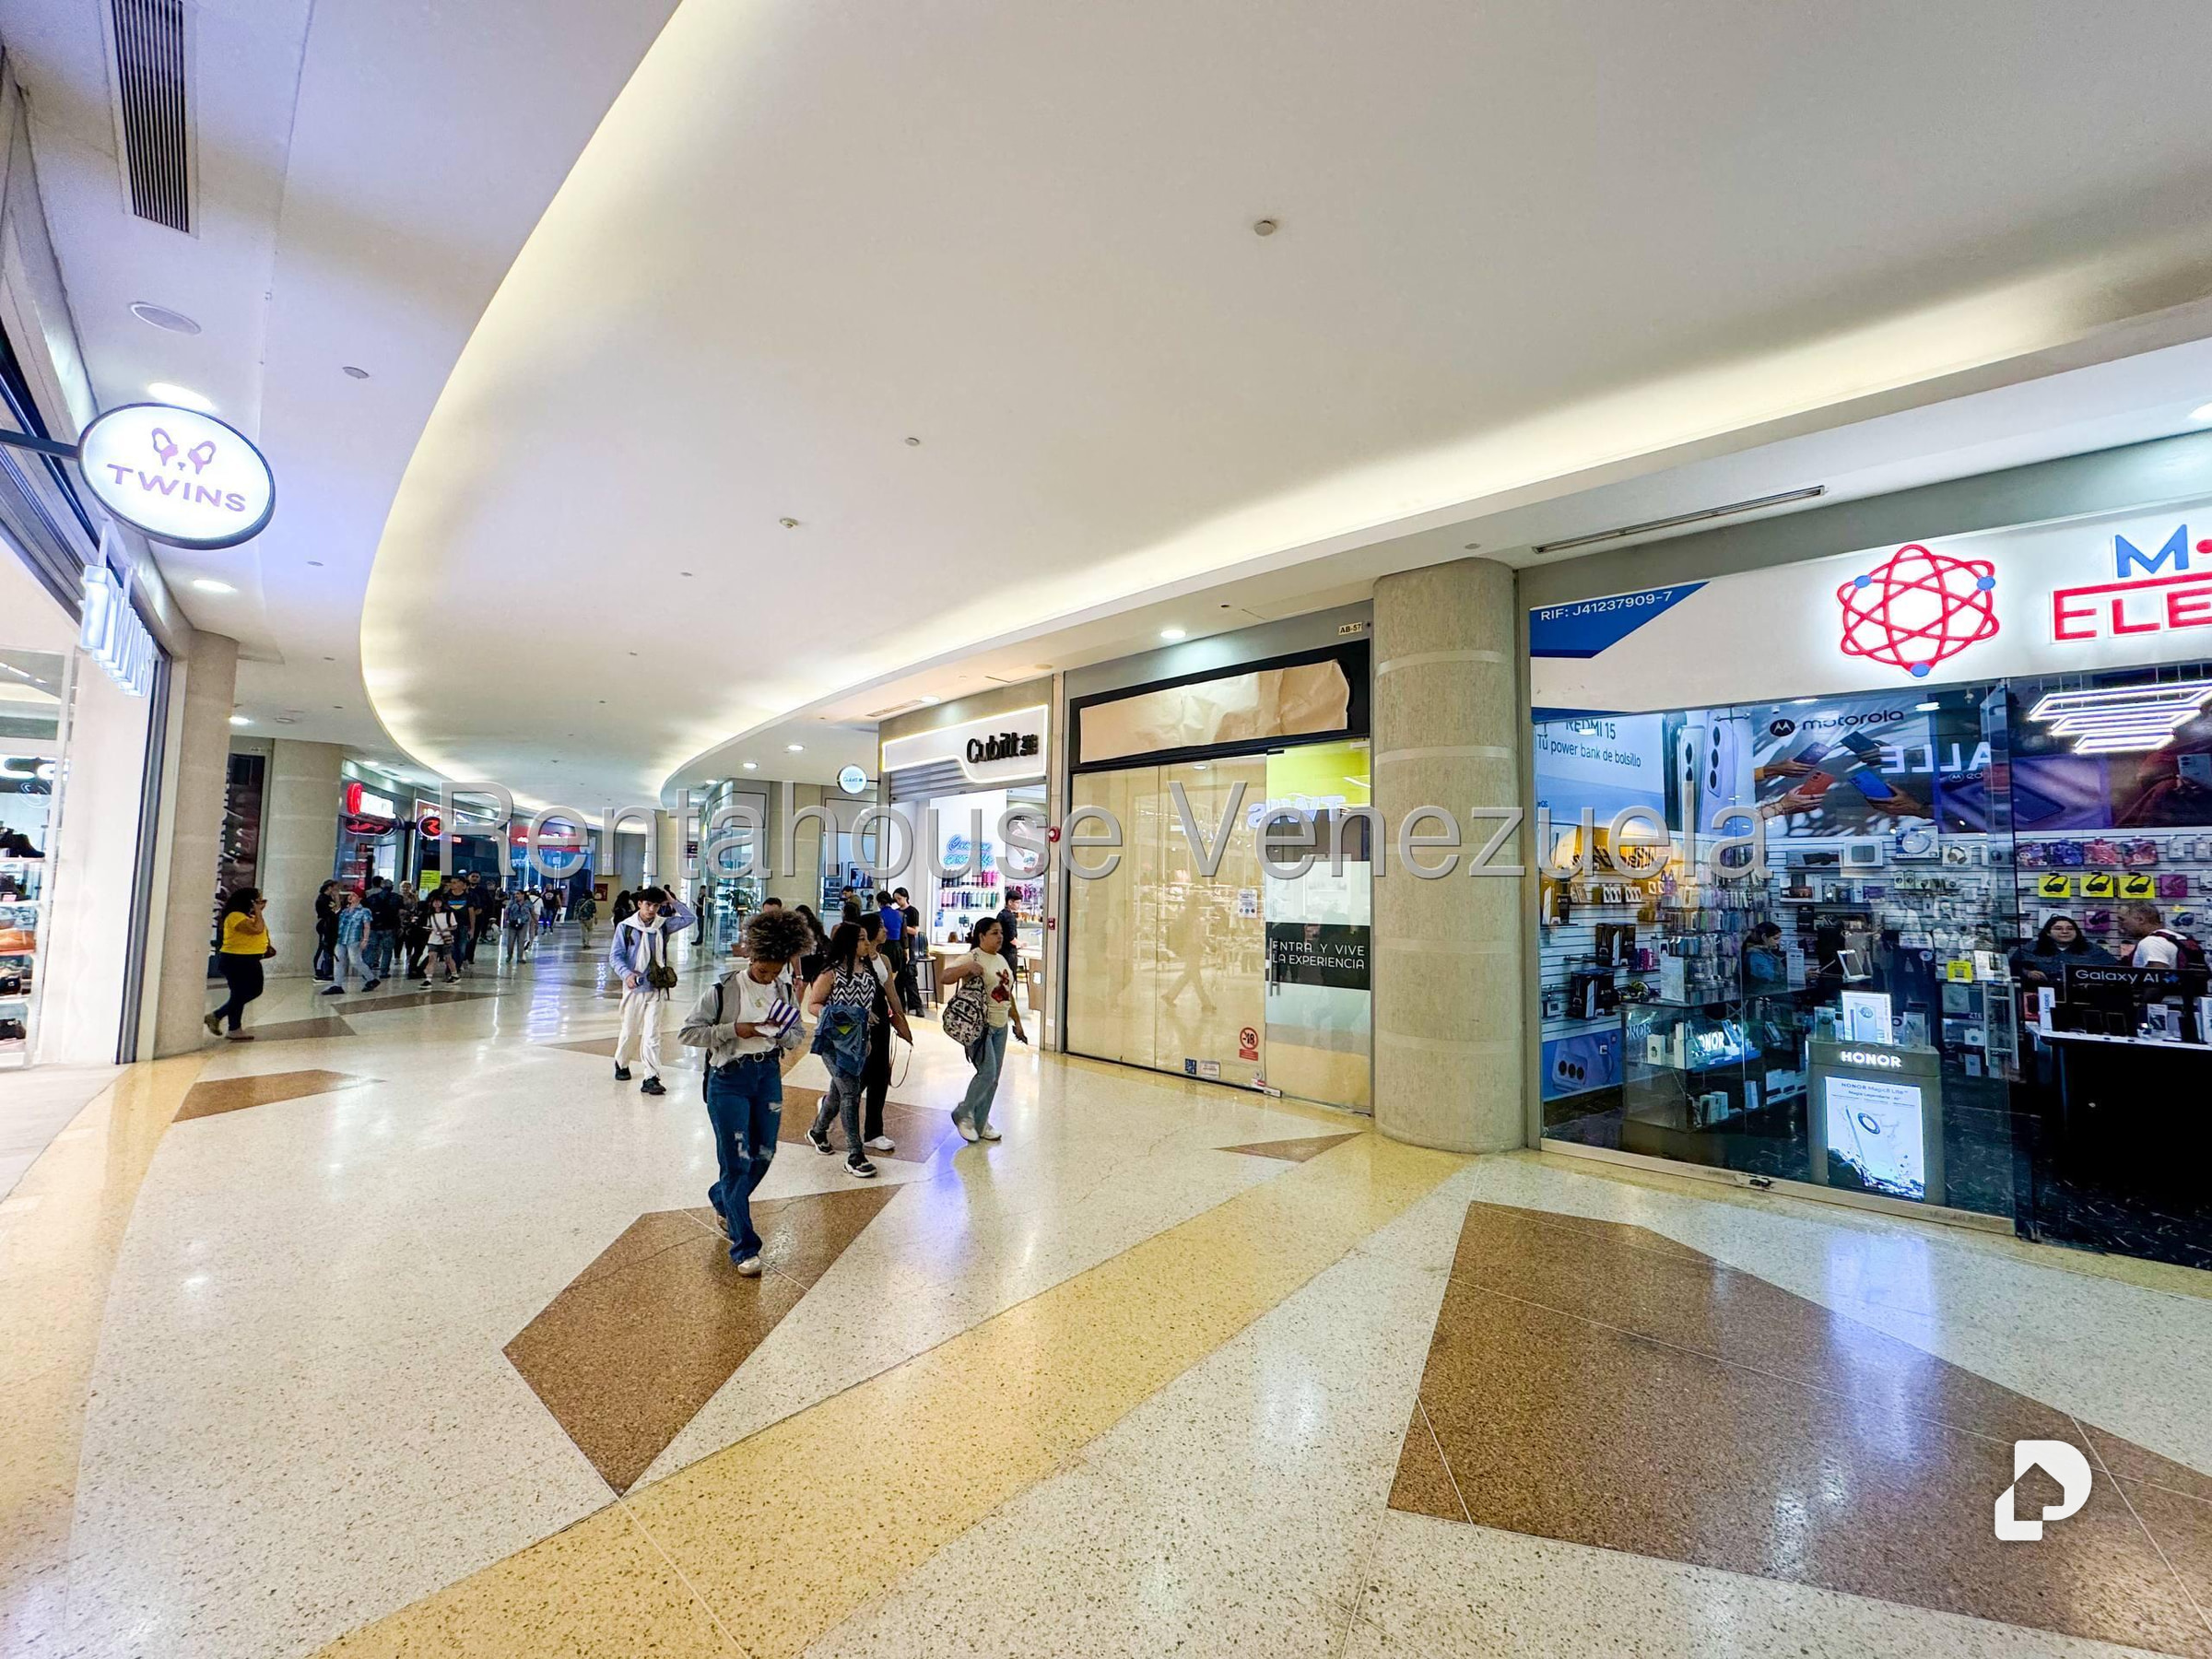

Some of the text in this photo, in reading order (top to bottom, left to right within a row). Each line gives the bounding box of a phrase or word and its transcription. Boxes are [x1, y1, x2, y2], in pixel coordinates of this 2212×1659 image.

[106, 463, 246, 512] TWINS
[1540, 591, 1673, 621] RIF: J41237909-7
[1339, 623, 1361, 634] AB-57
[1802, 709, 1904, 731] motorola
[1605, 722, 1617, 740] 15
[1550, 740, 1579, 755] power
[1581, 743, 1601, 760] bank
[1603, 747, 1613, 762] de
[1615, 752, 1641, 768] bolsillo
[1272, 940, 1365, 957] ENTRA Y VIVE
[1272, 953, 1365, 970] LA EXPERIENCIA
[2075, 969, 2138, 984] Galaxy
[1626, 1022, 1652, 1041] ONOR
[1699, 1031, 1724, 1052] ONOR
[1841, 1051, 1902, 1068] HONOR
[1841, 1082, 1866, 1090] HONOR
